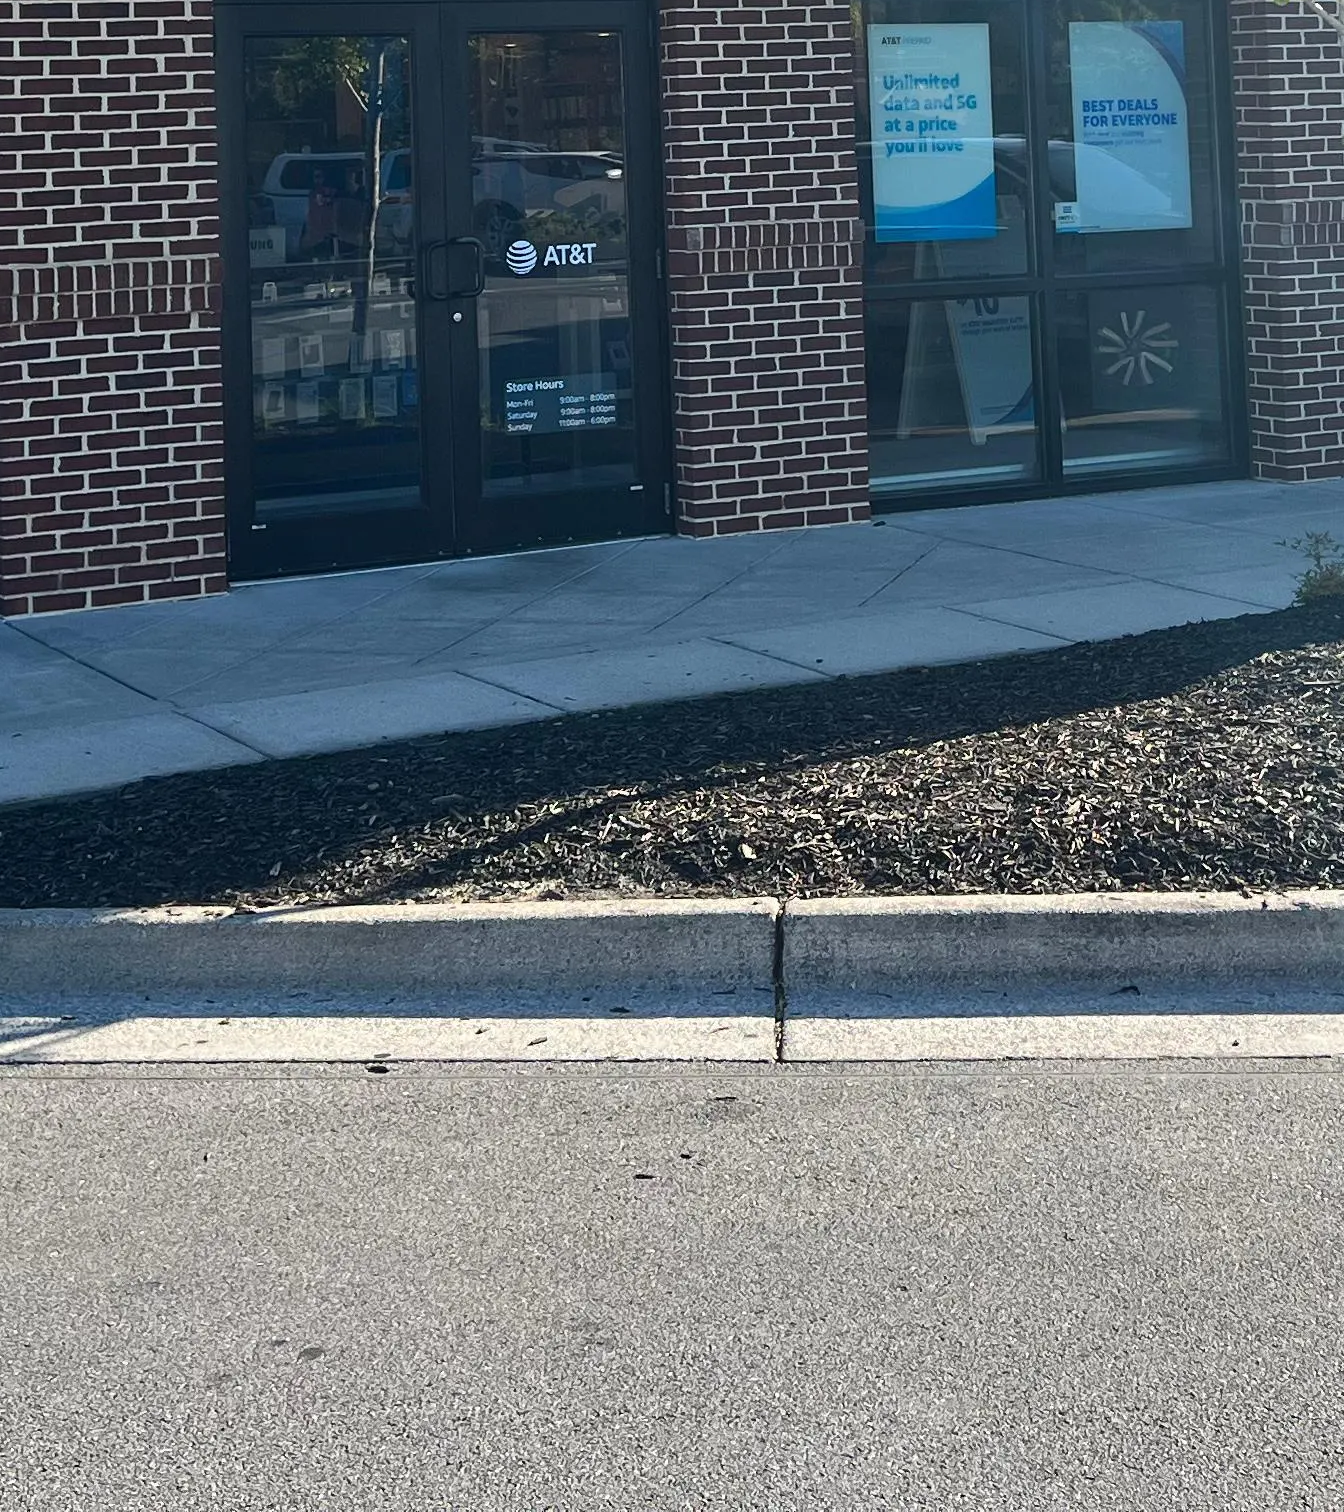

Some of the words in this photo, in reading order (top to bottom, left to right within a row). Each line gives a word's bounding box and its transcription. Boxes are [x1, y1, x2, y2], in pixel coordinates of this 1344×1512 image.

[881, 36, 901, 45] AT&T
[883, 72, 960, 90] Unlimited
[884, 94, 920, 111] data
[924, 94, 953, 111] and
[956, 94, 977, 110] 5G
[1082, 99, 1114, 113] BEST
[1117, 98, 1159, 111] DEALS
[884, 117, 902, 133] at
[905, 119, 915, 132] a
[918, 115, 957, 136] price
[1083, 115, 1109, 128] FOR
[1111, 113, 1178, 127] EVERYONE
[932, 136, 964, 153] love
[543, 242, 597, 267] AT&T
[506, 382, 534, 393] Store
[535, 380, 564, 390] Hours
[506, 399, 534, 409] Mon-Fri
[507, 411, 538, 421] Saturday
[507, 423, 533, 432] Sunday
